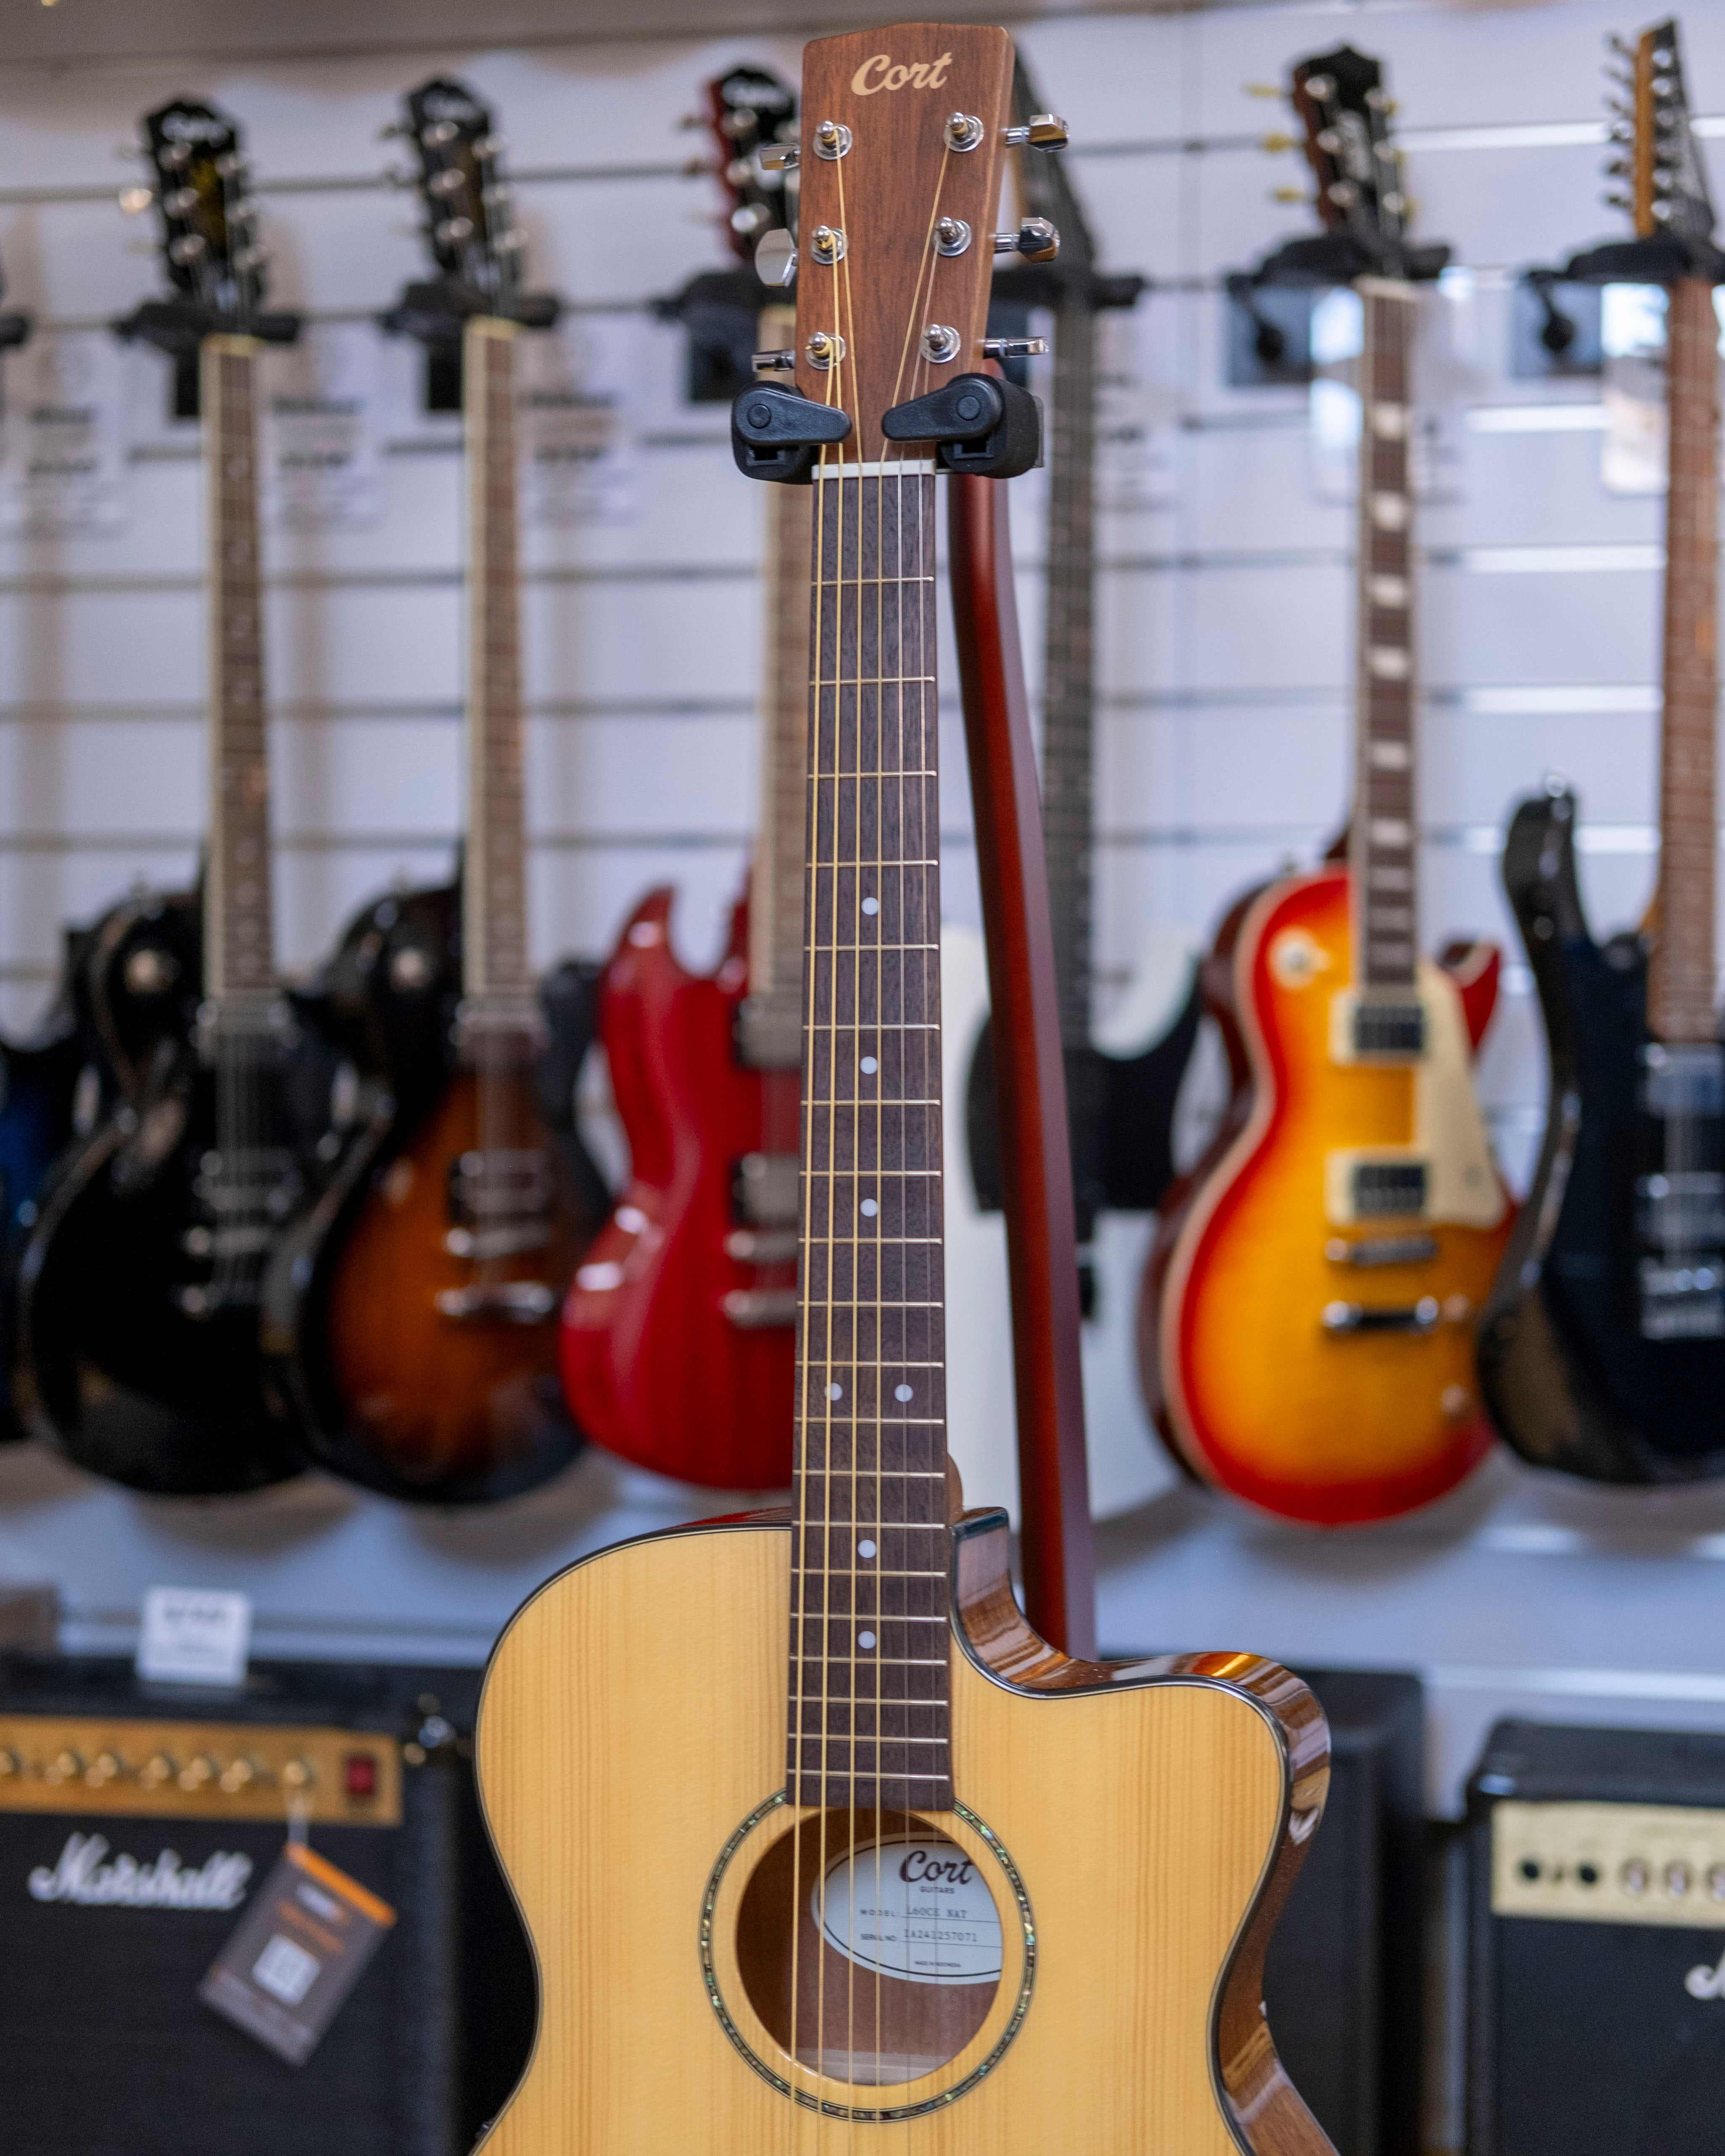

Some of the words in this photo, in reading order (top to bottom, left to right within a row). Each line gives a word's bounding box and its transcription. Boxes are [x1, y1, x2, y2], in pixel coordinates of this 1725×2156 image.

[851, 52, 953, 96] Cort
[28, 1830, 253, 1911] Marshall
[899, 1850, 974, 1885] Cort
